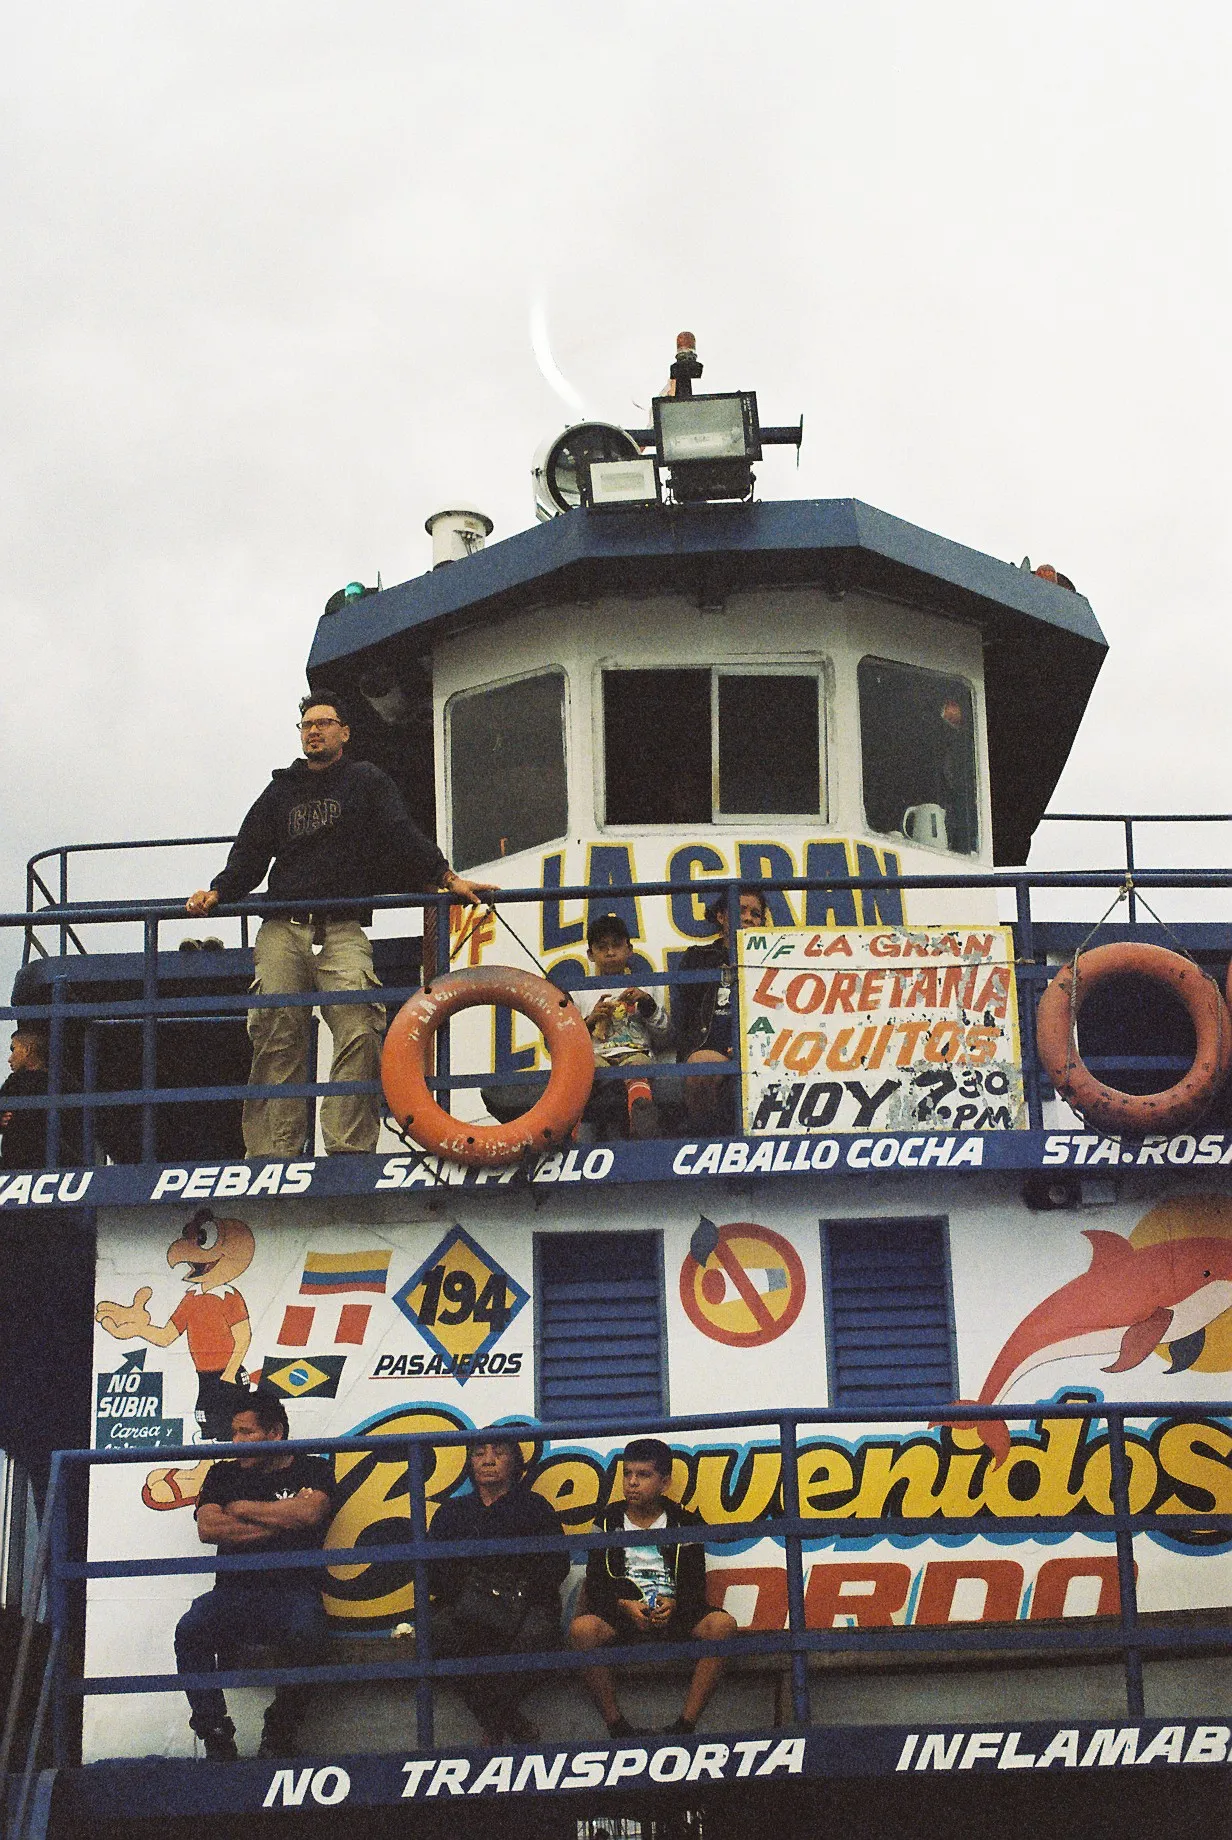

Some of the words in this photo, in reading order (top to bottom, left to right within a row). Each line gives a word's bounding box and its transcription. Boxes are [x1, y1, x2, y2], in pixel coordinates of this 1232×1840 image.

[289, 798, 342, 838] GAP
[540, 840, 646, 956] LA
[666, 839, 909, 944] GRAN
[803, 934, 854, 959] LA
[868, 934, 995, 959] GRAN
[752, 966, 1012, 1019] LORETANA
[747, 1016, 776, 1035] A
[763, 1020, 1002, 1077] IQUITOS
[751, 1079, 903, 1131] HOY
[375, 1154, 468, 1189] SAN
[672, 1140, 840, 1175] CABALLO
[846, 1137, 984, 1168] COCHA
[0, 1171, 94, 1205] ACU
[150, 1161, 316, 1200] PEBAS
[417, 1264, 511, 1333] 194
[107, 1374, 141, 1394] NO
[373, 1352, 524, 1376] PASAJEROS
[97, 1396, 159, 1418] SUBIR
[317, 1395, 1232, 1632] Bevenidos
[703, 1555, 1139, 1630] ORDO
[896, 1726, 1232, 1771] INFLAMAB
[262, 1766, 350, 1807] NO
[402, 1738, 806, 1797] TRANSPORTA
